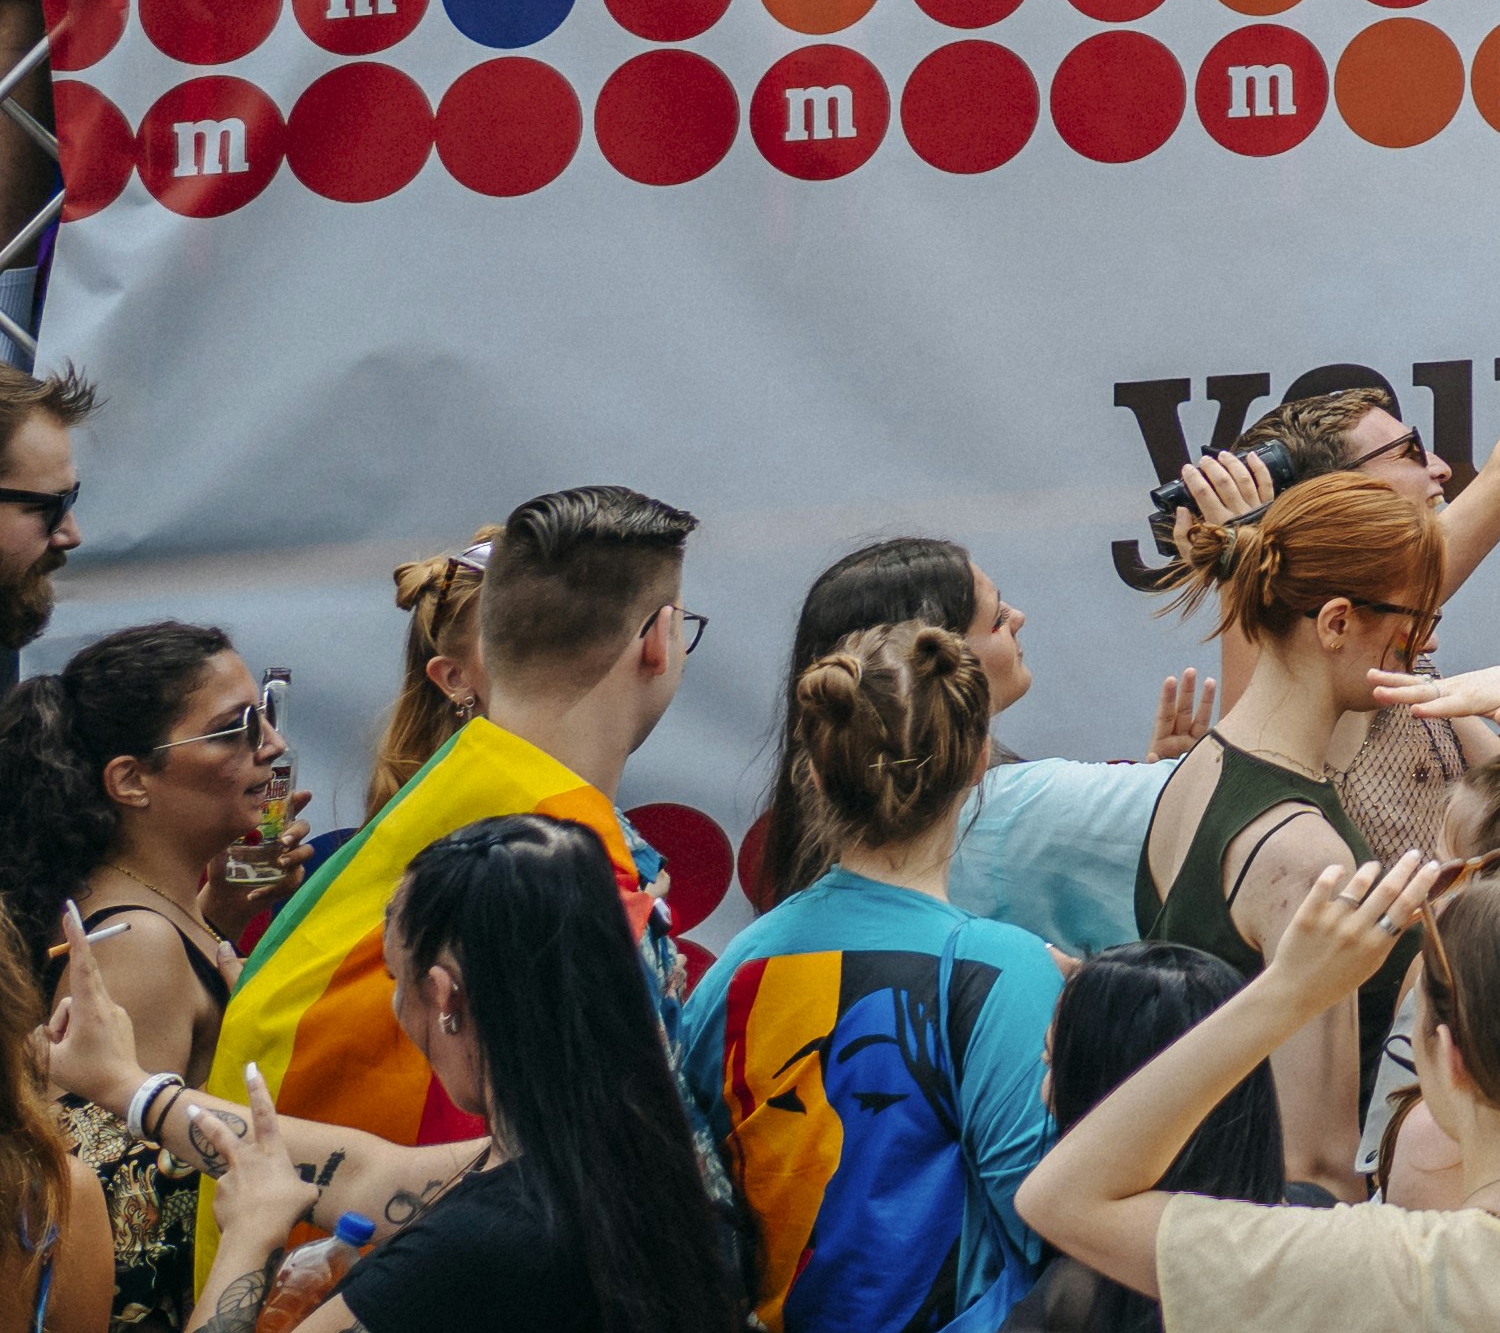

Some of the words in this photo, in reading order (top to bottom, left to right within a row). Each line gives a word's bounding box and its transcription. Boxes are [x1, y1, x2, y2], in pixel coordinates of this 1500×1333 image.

[173, 118, 249, 177] m
[785, 85, 857, 141] m
[1228, 64, 1296, 117] m
